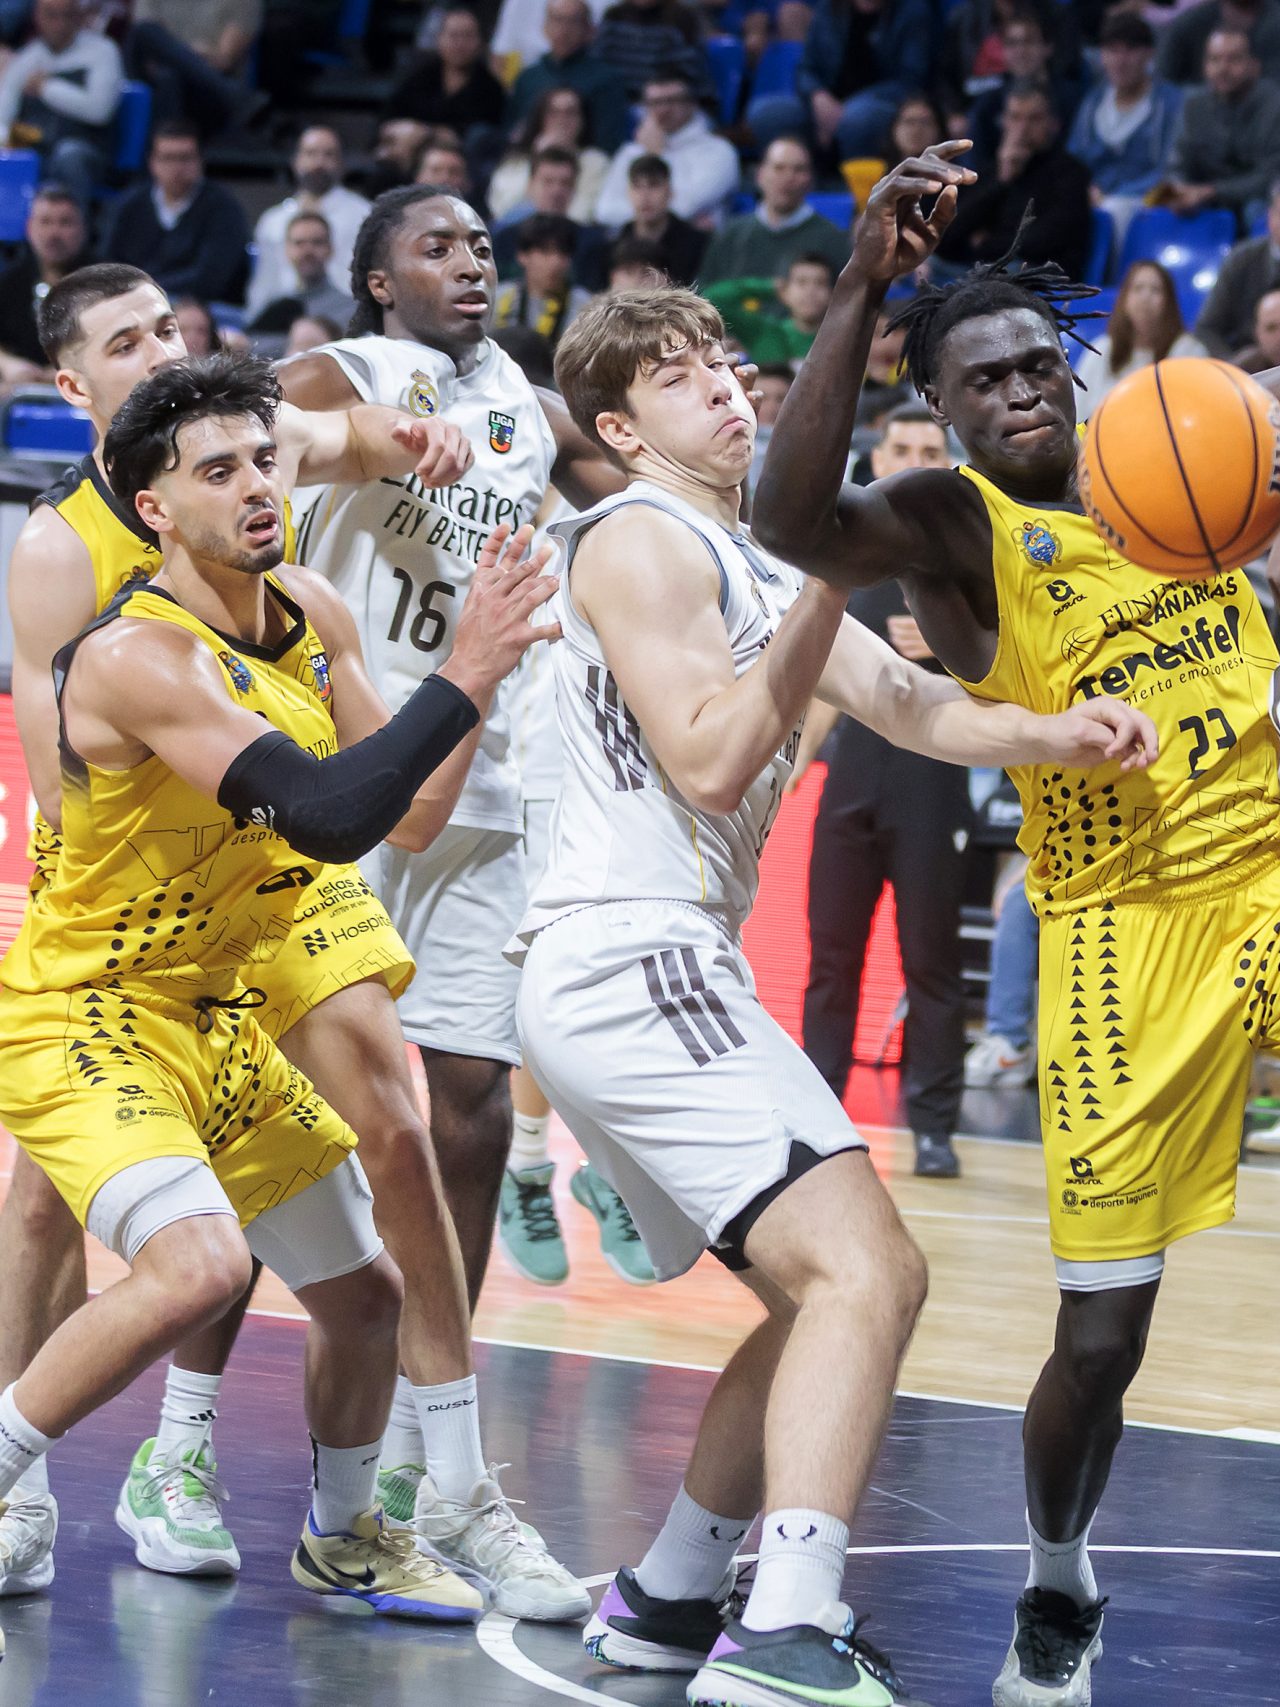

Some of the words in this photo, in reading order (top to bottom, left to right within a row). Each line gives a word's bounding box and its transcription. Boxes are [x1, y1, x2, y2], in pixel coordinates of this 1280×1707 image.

[491, 412, 514, 429] LIGA
[383, 499, 430, 539] FLY
[426, 516, 491, 564] BETTE
[387, 567, 456, 652] 16
[317, 879, 355, 898] Islas
[330, 913, 394, 945] Hospit
[1090, 1199, 1125, 1209] deporte
